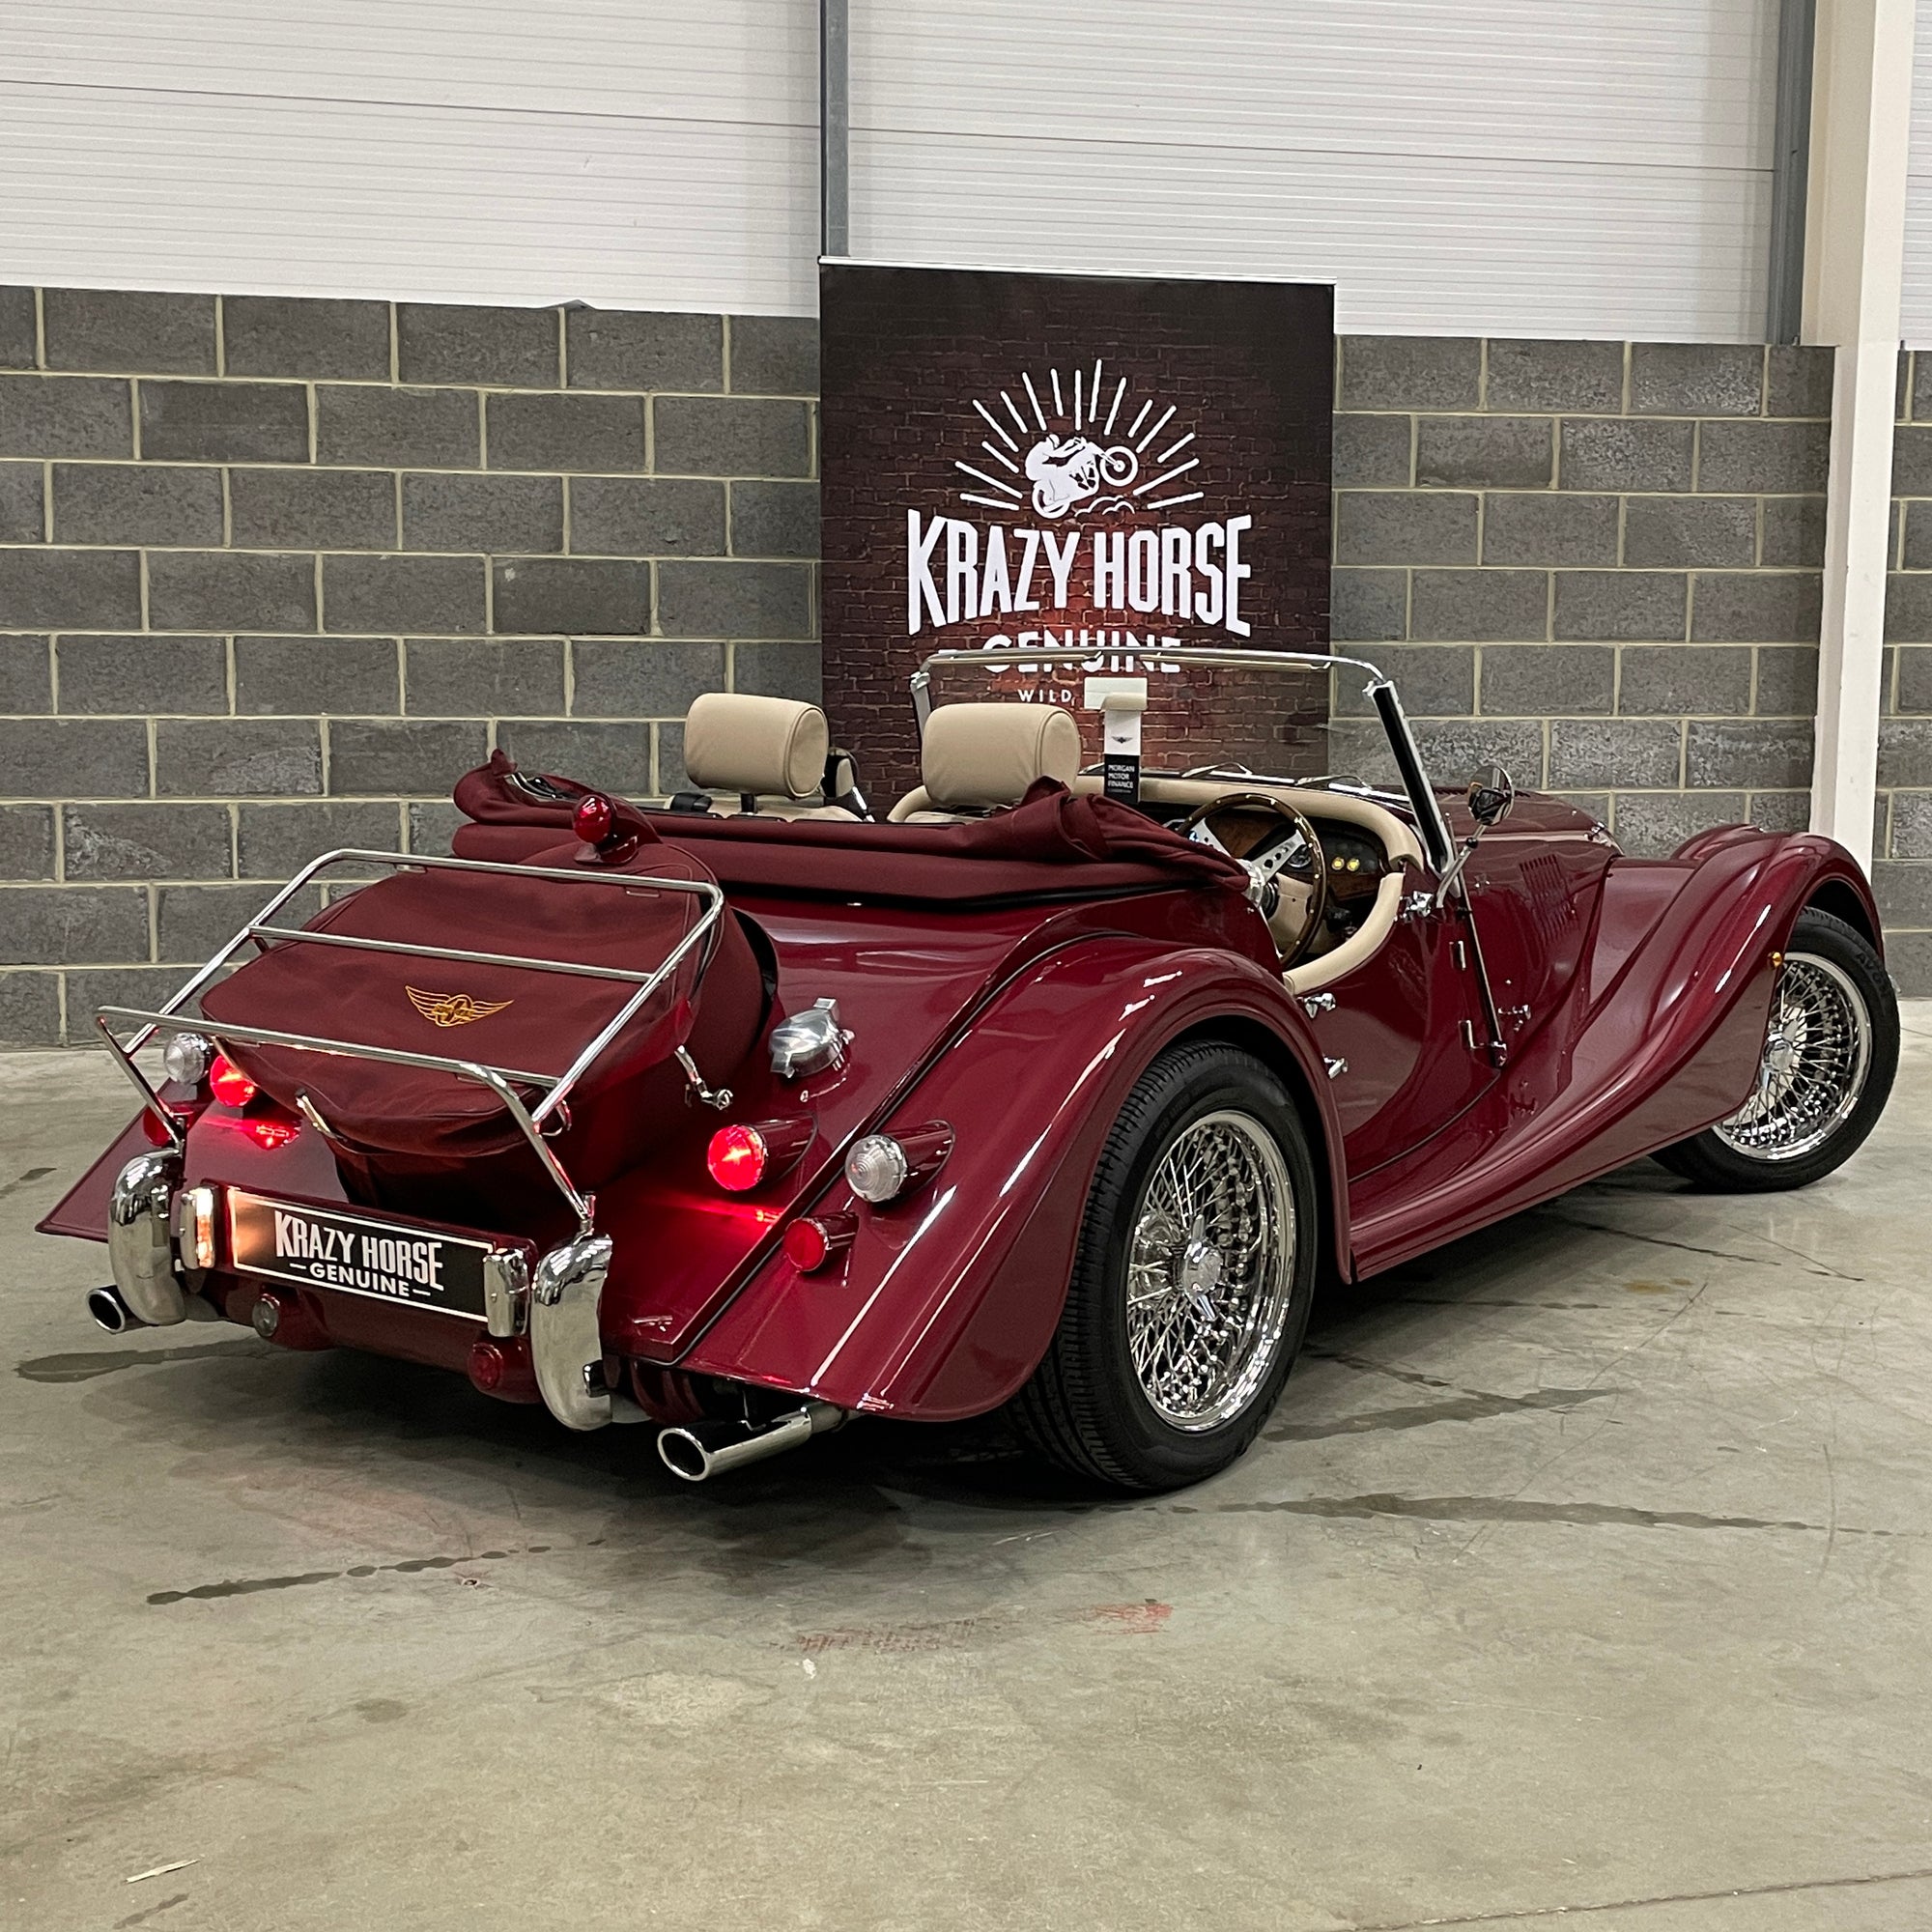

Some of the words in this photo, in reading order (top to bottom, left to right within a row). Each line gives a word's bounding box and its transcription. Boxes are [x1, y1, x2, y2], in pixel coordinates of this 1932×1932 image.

[908, 509, 1081, 636] KRAZY
[1094, 514, 1252, 638] HORSE
[1108, 764, 1135, 773] MORGAN
[1108, 780, 1133, 788] FINANCE
[275, 1210, 355, 1263] KRAZY
[362, 1236, 444, 1291] HORSE
[310, 1263, 410, 1296] GENUINE
